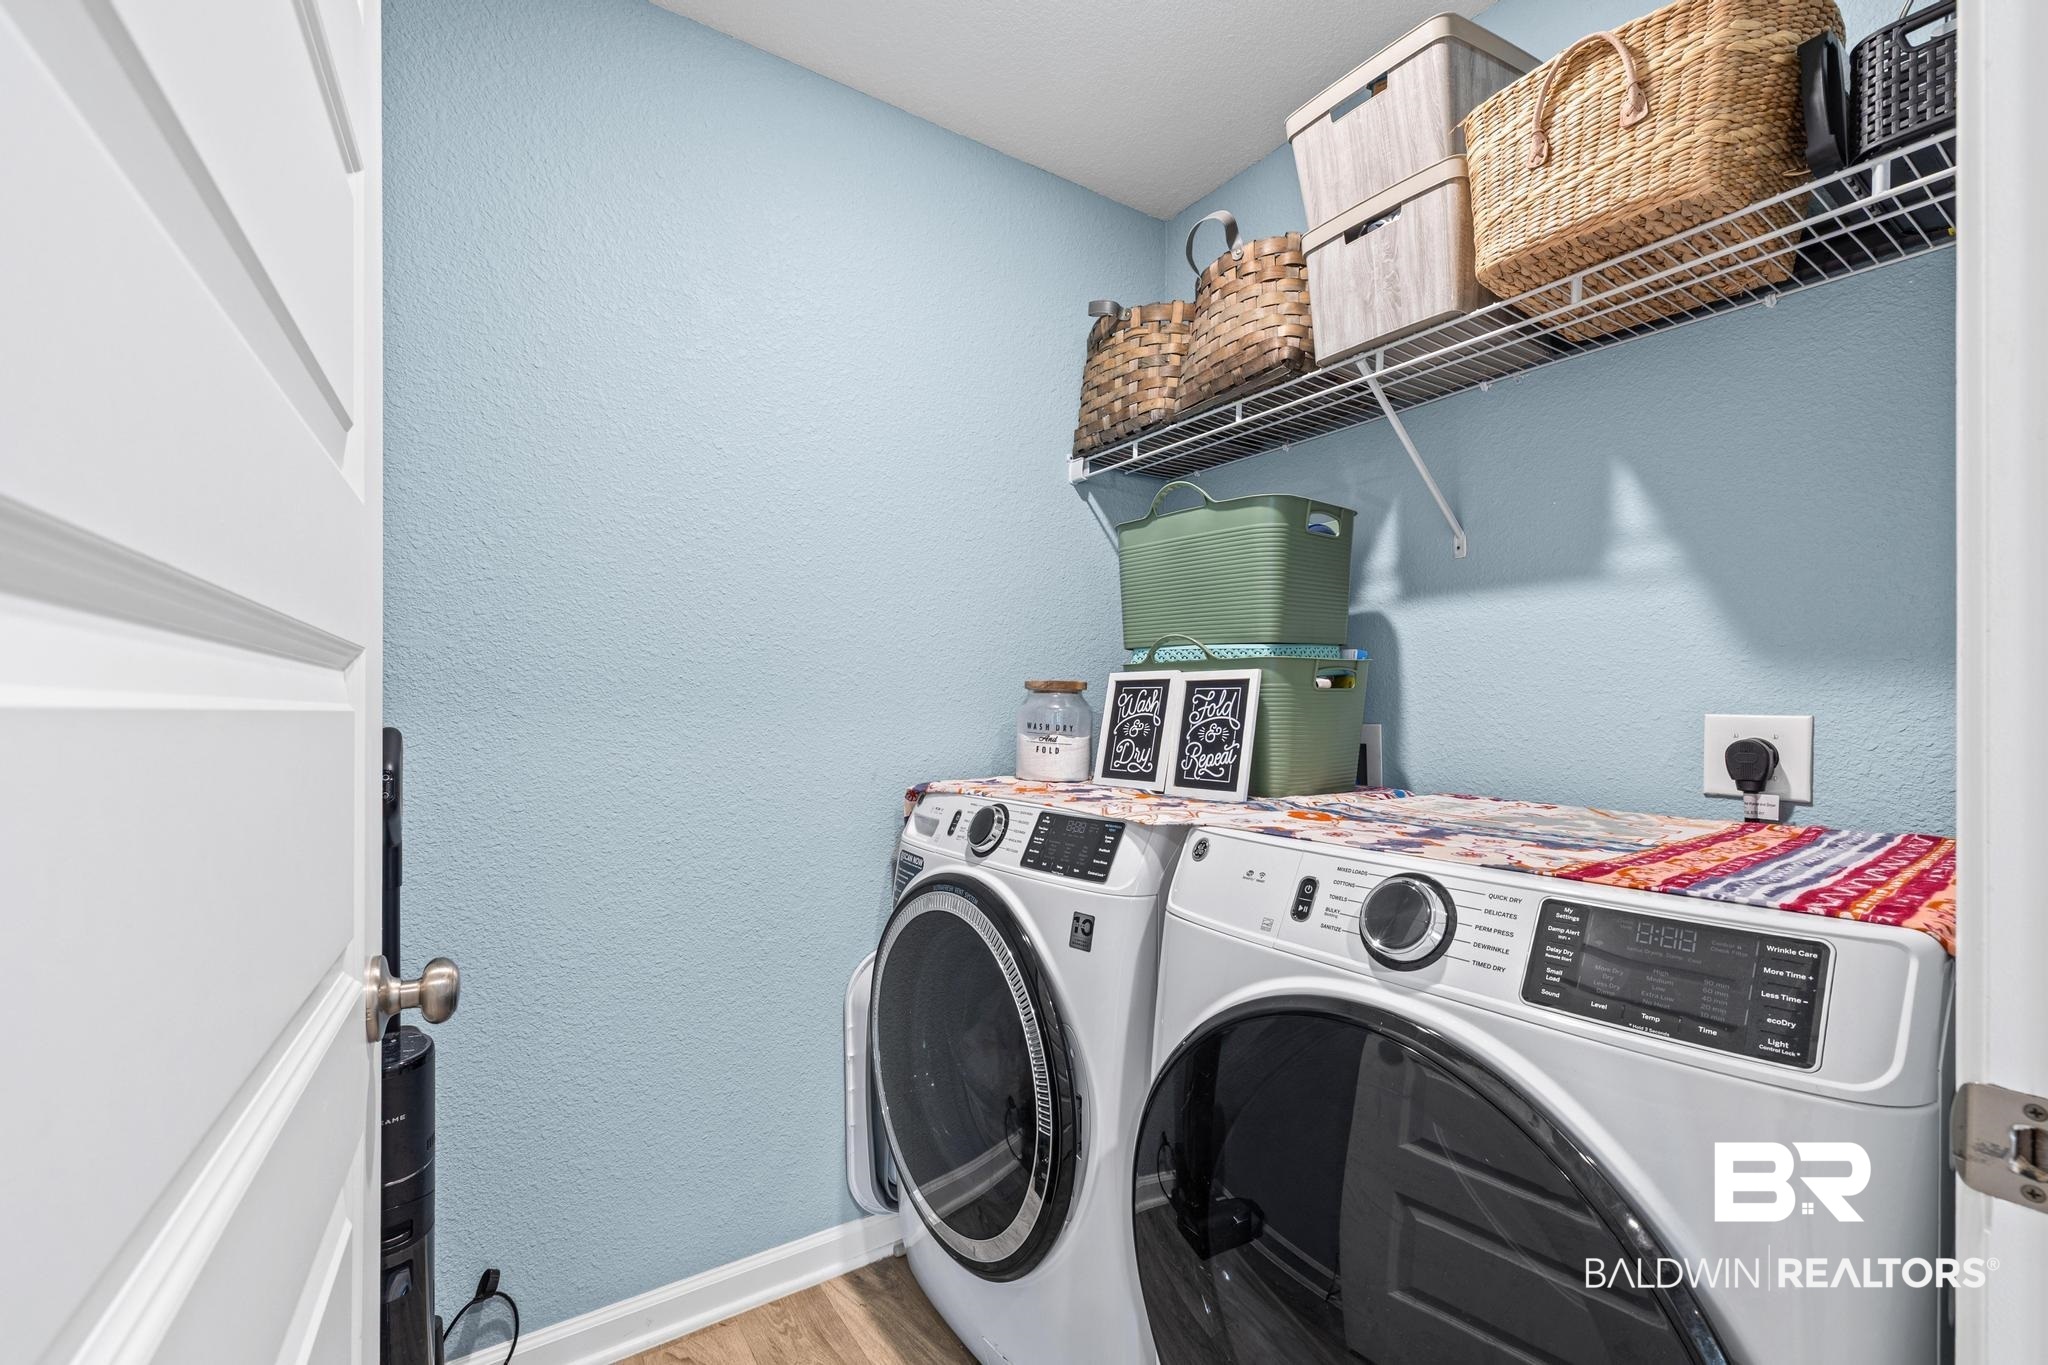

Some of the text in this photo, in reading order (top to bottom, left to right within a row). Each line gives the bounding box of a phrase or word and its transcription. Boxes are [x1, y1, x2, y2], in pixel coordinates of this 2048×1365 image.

[1118, 690, 1160, 722] Wash
[1189, 690, 1240, 727] Fold
[1027, 722, 1050, 730] WASH
[1129, 719, 1144, 737] &
[1205, 724, 1222, 742] &
[1036, 746, 1060, 754] FOLD
[1114, 739, 1152, 772] Dry
[1182, 742, 1240, 780] Repeat
[1333, 880, 1356, 888] COTTONS
[1488, 893, 1508, 902] QUICK
[1484, 908, 1518, 920] DELICATES
[1556, 912, 1580, 922] Settings
[1320, 923, 1342, 932] SANITIZE
[1474, 924, 1514, 938] PERM PRESS
[1548, 926, 1580, 936] Damp Alert
[1472, 942, 1510, 955] DEWRINKLE
[1546, 946, 1574, 957] Delay Dry
[1766, 945, 1818, 958] Wrinkle Care
[1472, 960, 1492, 970] TIMED
[1546, 968, 1562, 976] Small
[1764, 967, 1784, 976] More
[1785, 970, 1806, 980] Time
[1546, 974, 1560, 982] Load
[1541, 988, 1560, 998] Sound
[1761, 990, 1780, 1000] Less
[1780, 994, 1802, 1004] Time
[1591, 1001, 1608, 1010] Level
[1642, 1012, 1660, 1023] Temp
[1766, 1018, 1796, 1029] ecoDry
[1649, 1028, 1670, 1036] Seconds
[1698, 1026, 1718, 1036] Time
[1768, 1038, 1788, 1048] Light
[1758, 1044, 1780, 1053] Control
